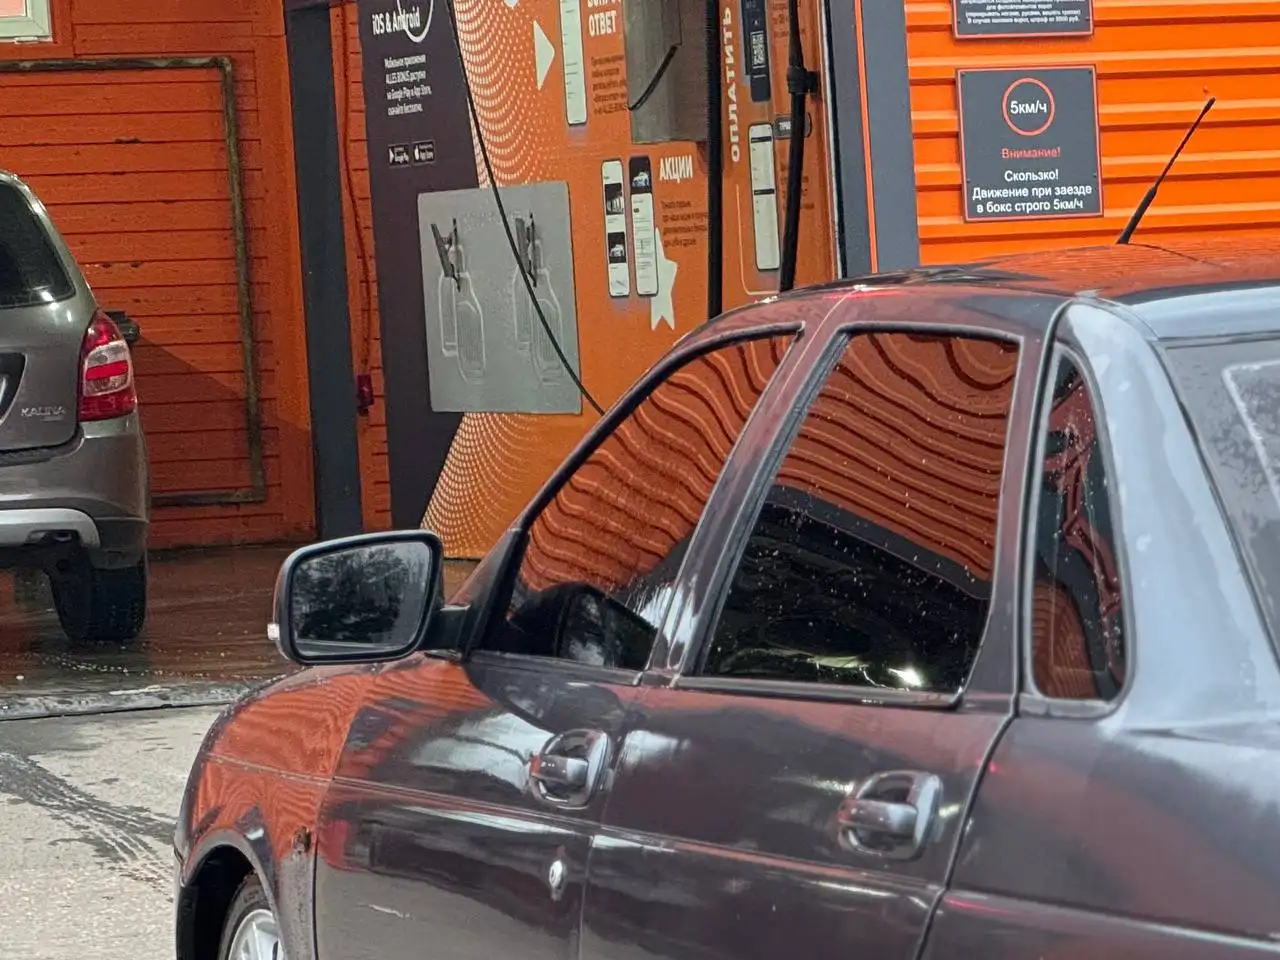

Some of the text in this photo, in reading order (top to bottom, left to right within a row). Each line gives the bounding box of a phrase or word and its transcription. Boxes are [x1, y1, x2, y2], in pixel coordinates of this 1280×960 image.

[372, 6, 421, 35] iOS & Android
[588, 10, 617, 37] ОТВЕТ
[723, 6, 741, 163] ОПЛАТИТЬ
[1010, 100, 1047, 115] 5км/ч
[1002, 147, 1061, 159] Внимание!
[660, 154, 693, 184] АКЦИИ
[1004, 169, 1059, 182] Скользко!
[972, 185, 1092, 200] Движение при заезде
[977, 198, 1084, 213] в бокс строго 5км/ч
